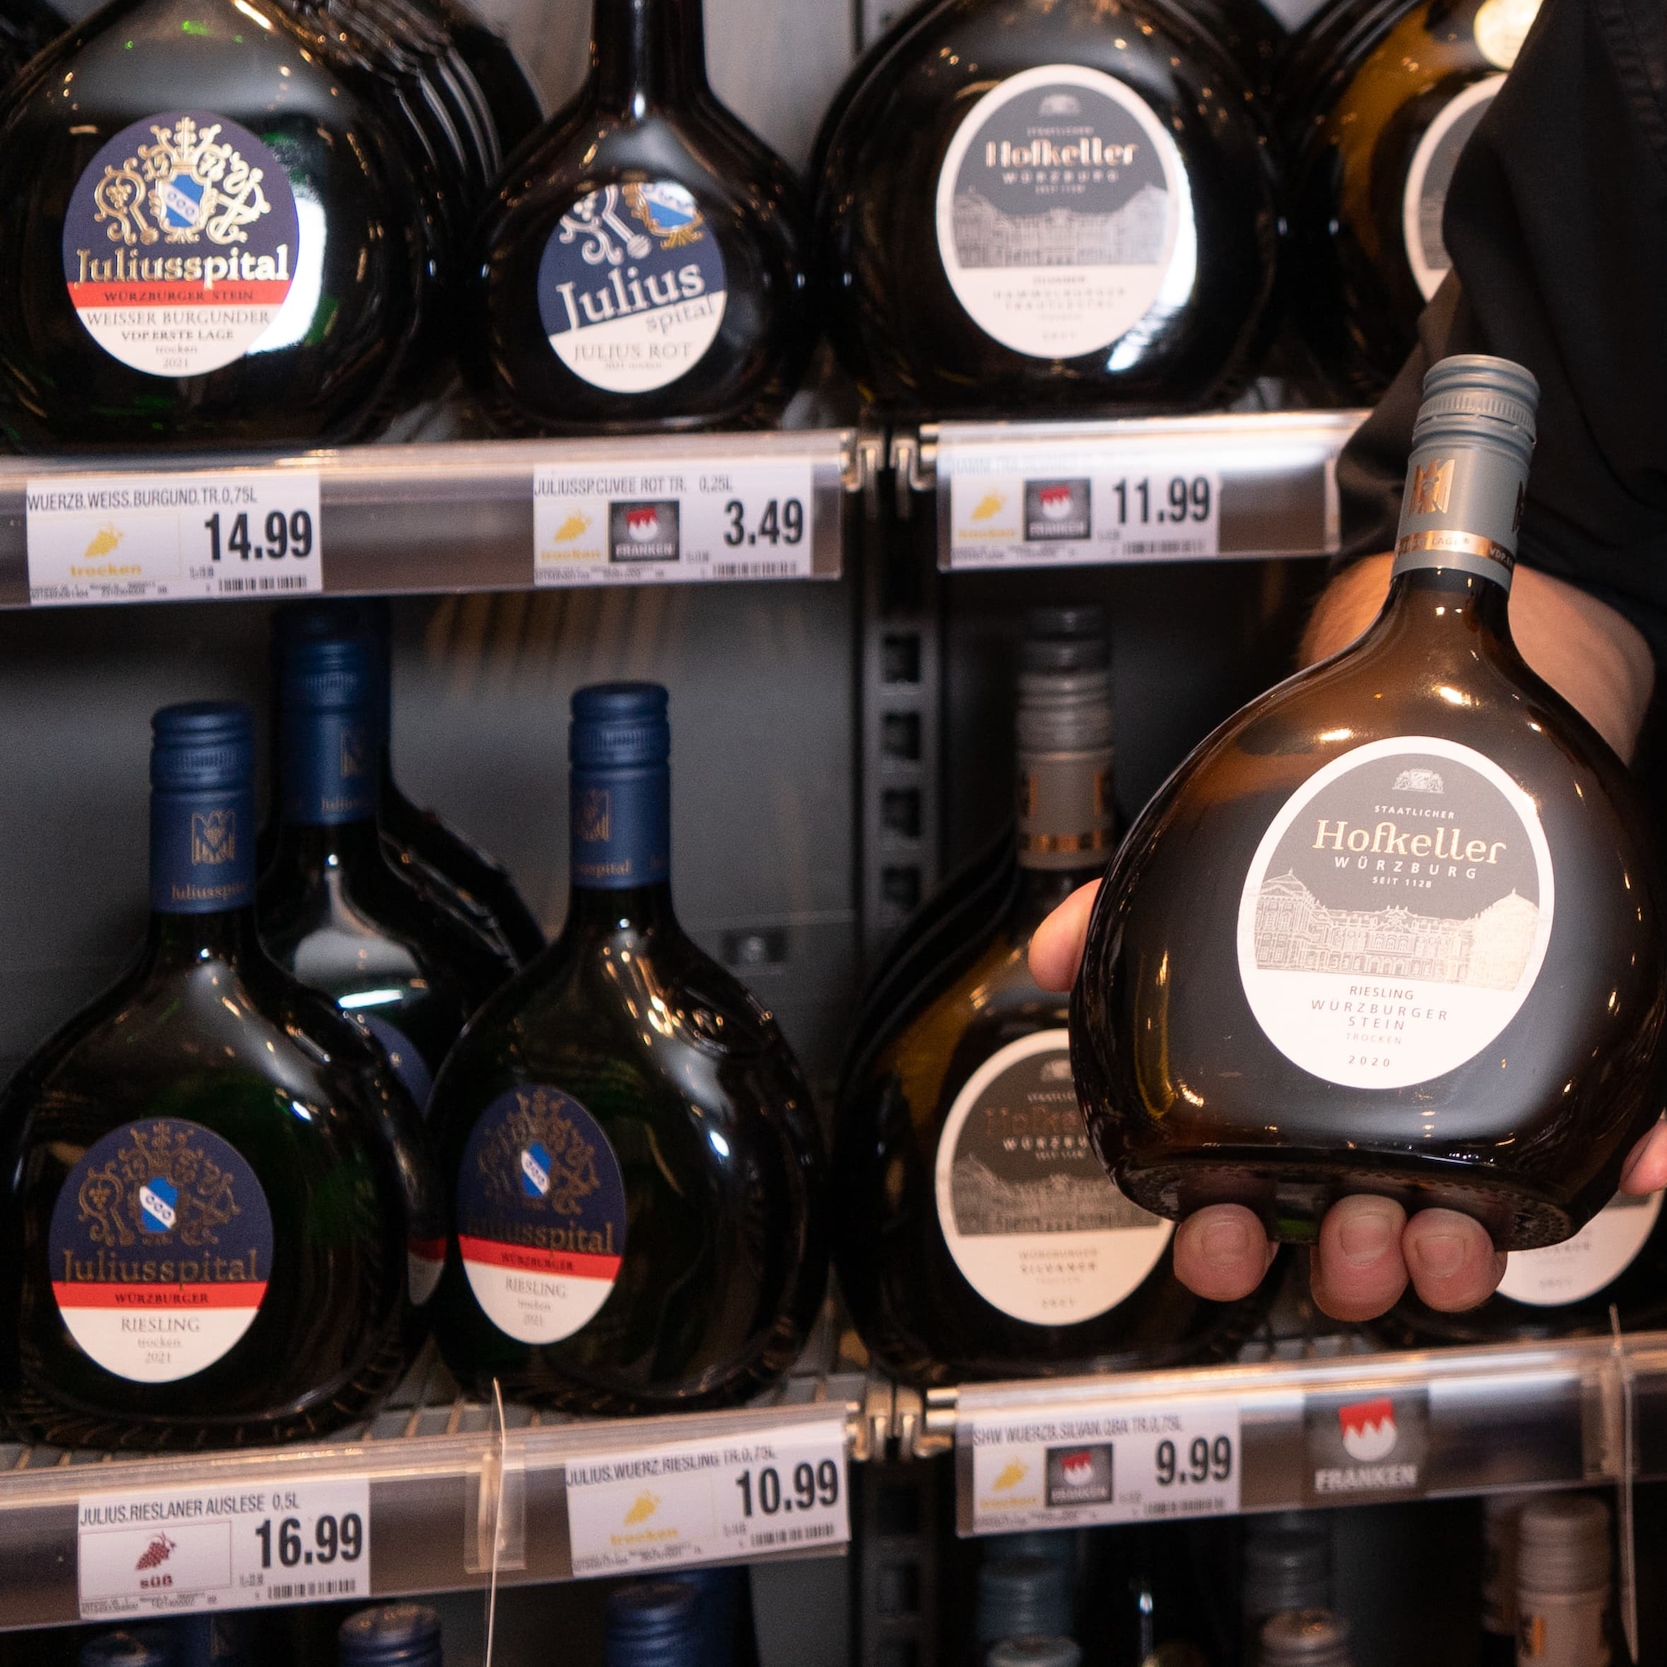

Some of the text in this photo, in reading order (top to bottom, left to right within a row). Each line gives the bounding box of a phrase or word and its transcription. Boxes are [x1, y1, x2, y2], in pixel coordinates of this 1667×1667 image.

[986, 136, 1140, 168] Hofkeller
[73, 243, 290, 290] Juliusspital
[104, 289, 254, 302] WÜRZBURGER STEIN
[555, 263, 706, 331] Julius
[86, 310, 270, 326] WEISSER BURGUNDER
[646, 292, 715, 335] spital
[198, 330, 234, 341] LAGE
[574, 341, 693, 362] JULIUS ROT
[640, 476, 665, 493] ROT
[1113, 476, 1211, 524] 11.99
[724, 498, 804, 546] 3.49
[205, 510, 313, 561] 14.99
[615, 543, 675, 558] FRANKEN
[1374, 804, 1456, 820] STAATLICHER
[1312, 818, 1508, 864] Hofkeller
[1334, 855, 1478, 880] WÜRZBURG
[1372, 876, 1433, 889] SEIT 1128
[1349, 985, 1415, 1001] RIESLING
[1311, 999, 1448, 1021] WÜRZBURGER
[1348, 1016, 1405, 1031] STEIN
[1345, 1032, 1402, 1045] TROCKEN
[1348, 1055, 1391, 1068] 2020
[62, 1247, 259, 1291] Juliusspital
[114, 1291, 209, 1305] WÜRZBURGER
[505, 1276, 567, 1299] RIESLING
[121, 1316, 201, 1333] RIESLING
[137, 1335, 182, 1348] trocken
[144, 1351, 172, 1365] 2021
[1157, 1435, 1232, 1486] 9.99
[736, 1459, 839, 1517] 10.99
[1313, 1464, 1418, 1495] FRANKEN
[80, 1491, 301, 1526] JULIUS.RIESLANER AUSLESE 0,5L
[255, 1513, 363, 1569] 16.99
